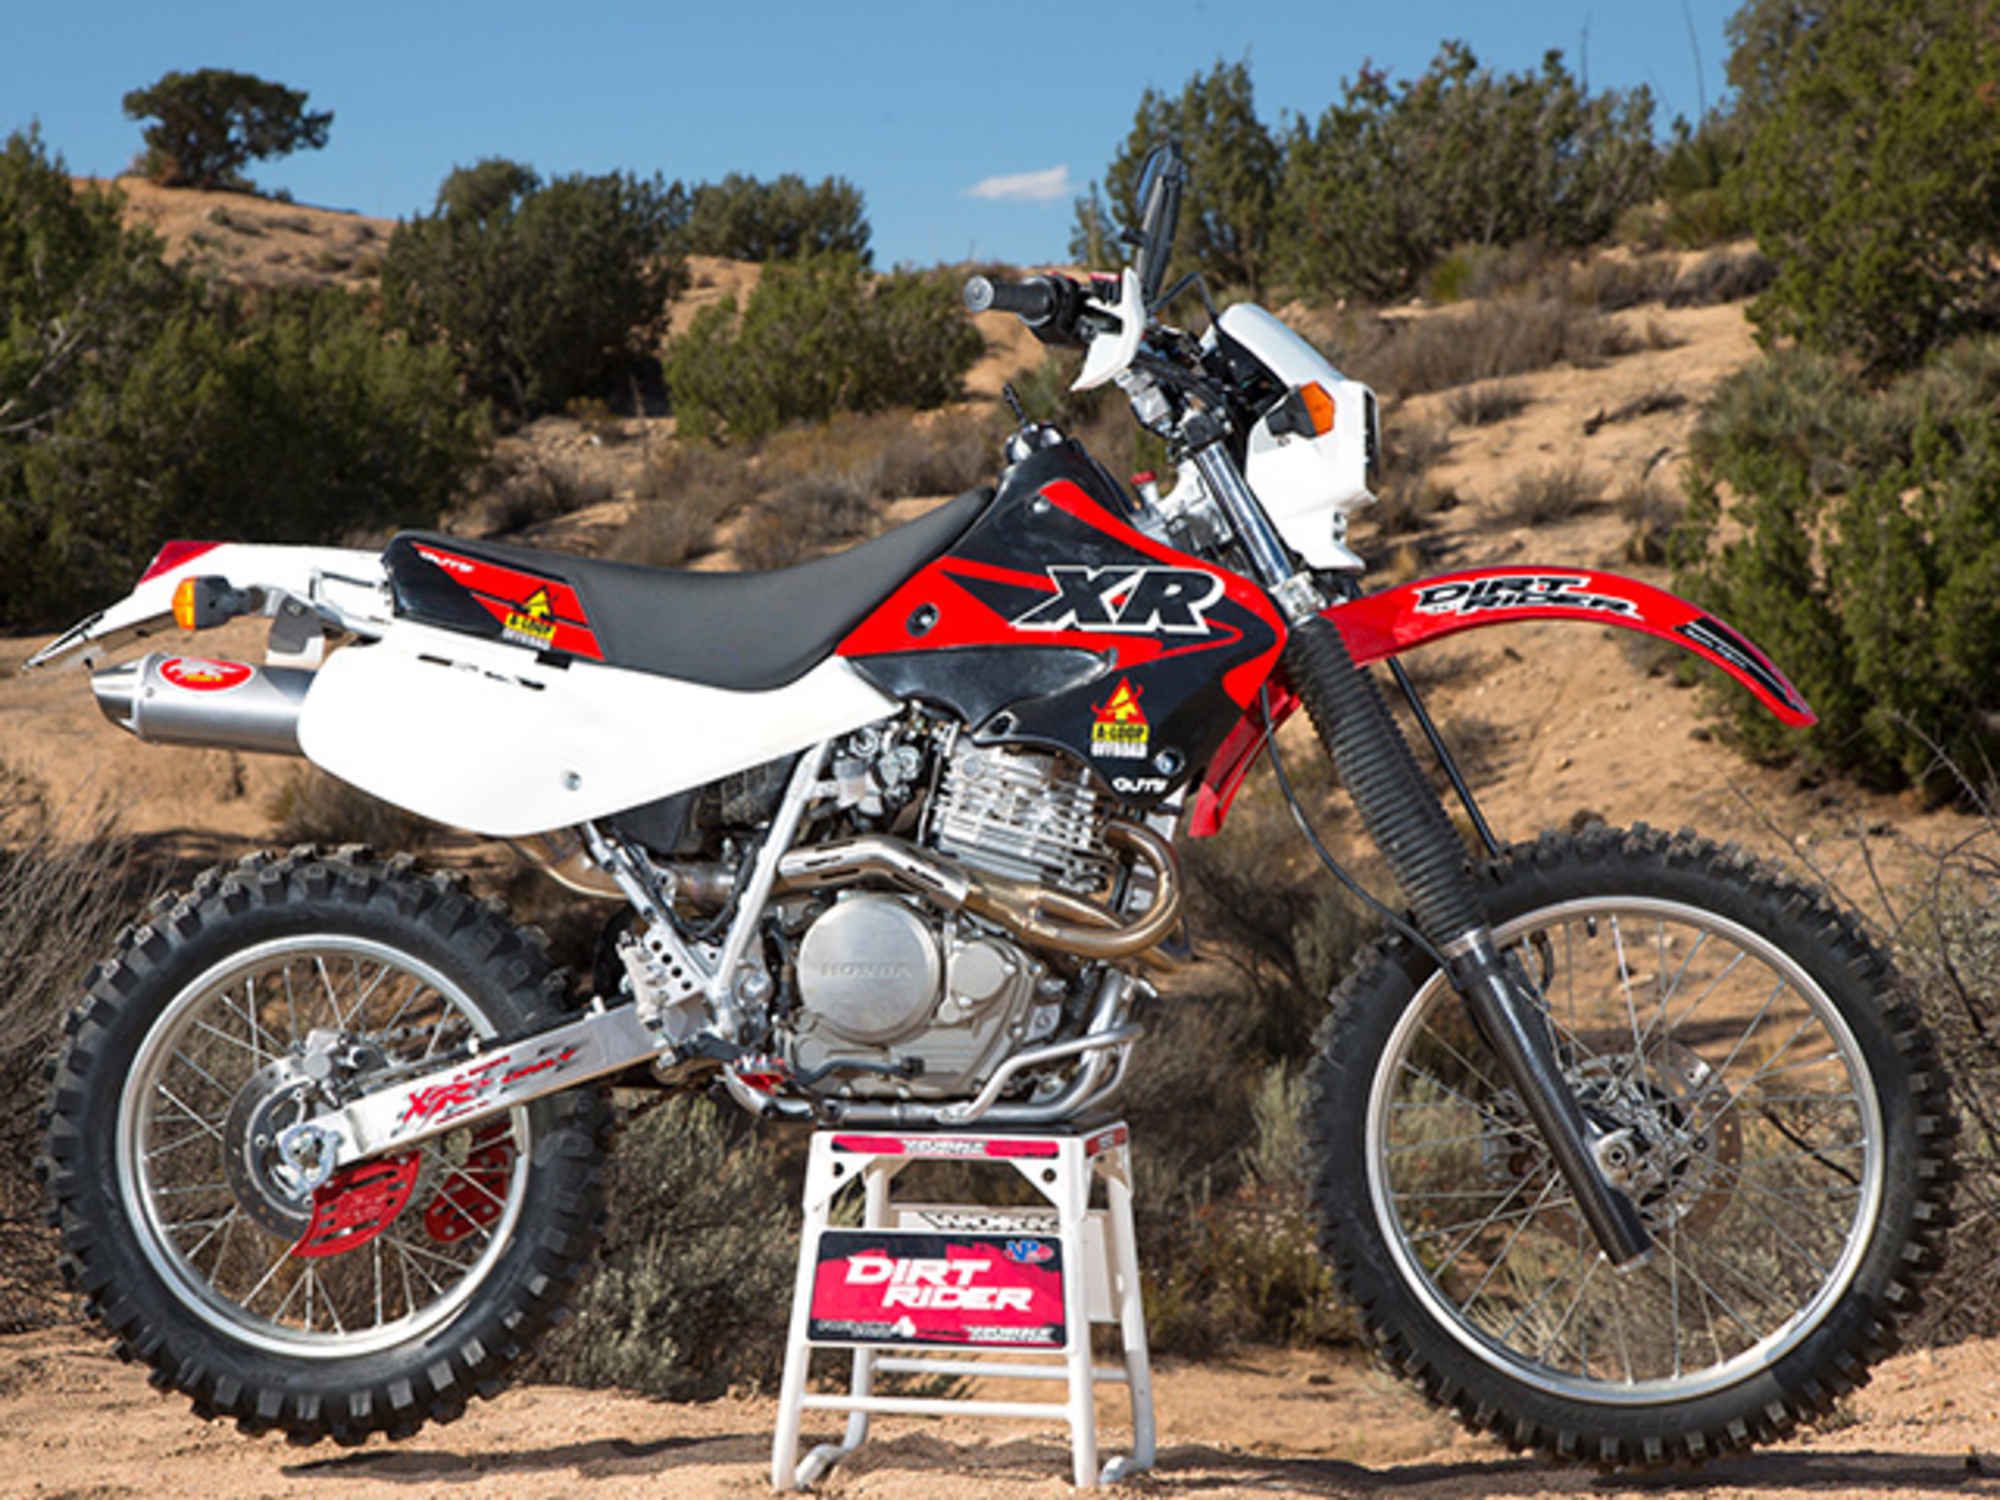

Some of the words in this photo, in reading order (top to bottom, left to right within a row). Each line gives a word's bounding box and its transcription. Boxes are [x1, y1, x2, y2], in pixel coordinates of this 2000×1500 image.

[1009, 565, 1225, 634] XR
[1412, 575, 1592, 614] DIRT
[1456, 590, 1645, 621] RIDER
[820, 961, 913, 979] HONDA
[844, 1255, 992, 1286] DIRT
[881, 1286, 1033, 1312] RIDER
